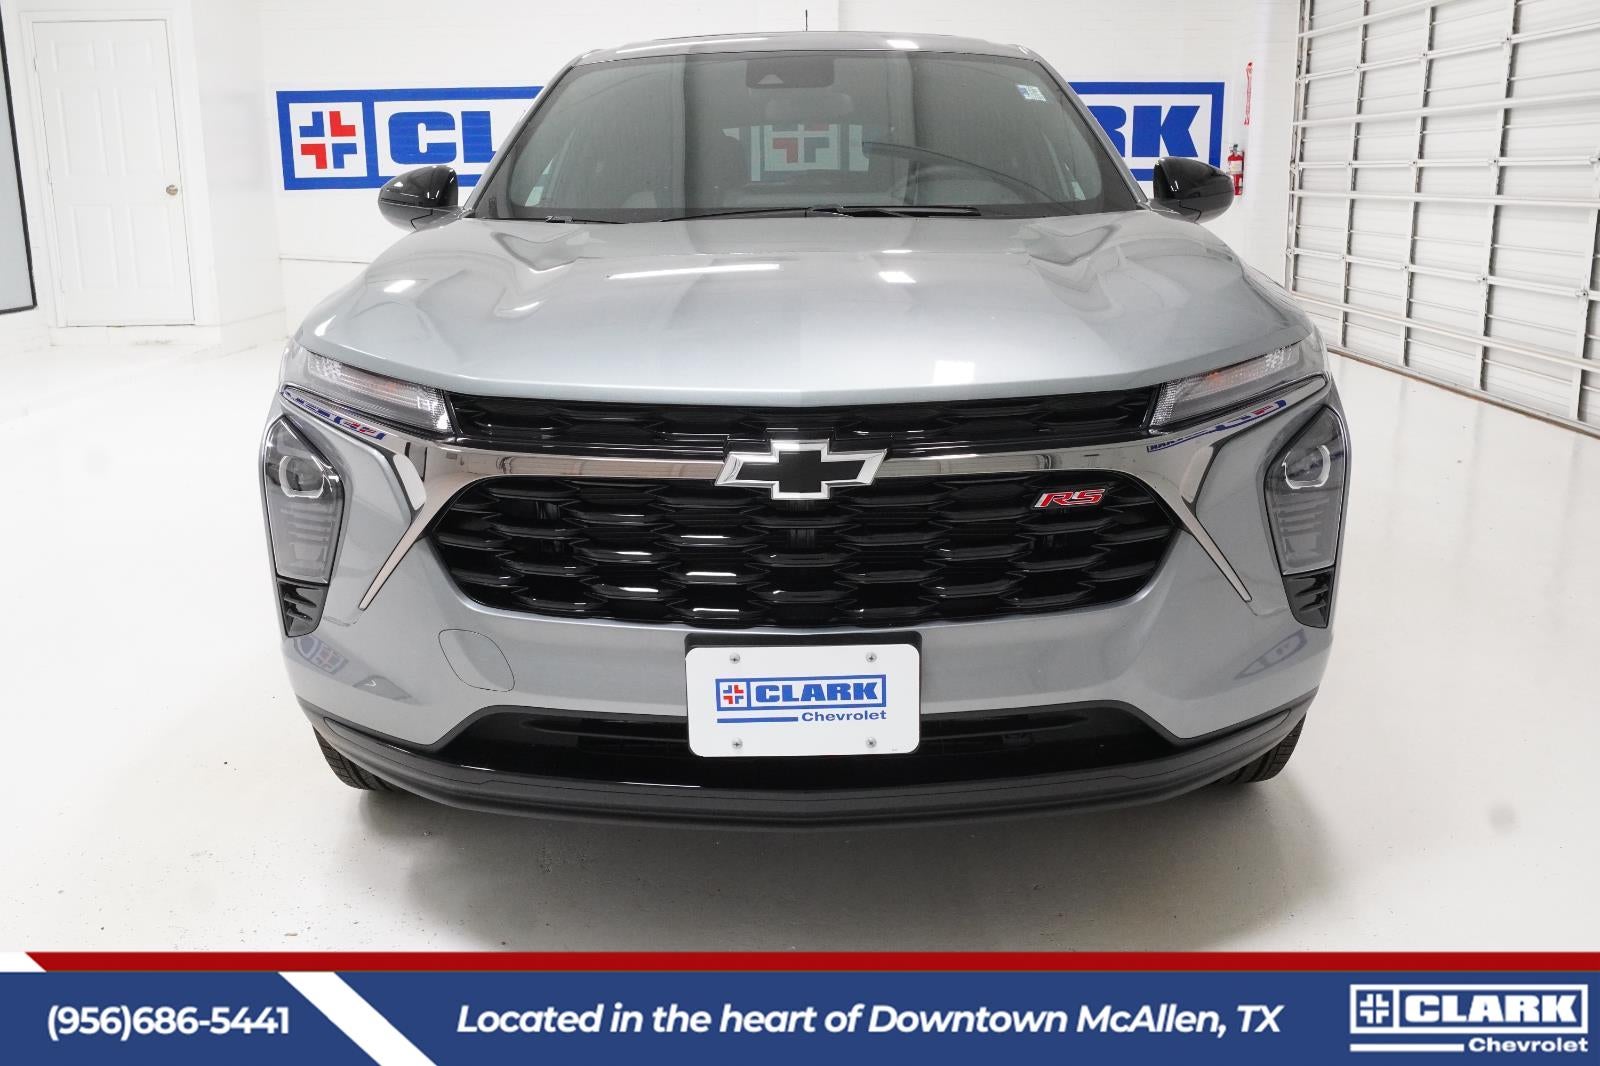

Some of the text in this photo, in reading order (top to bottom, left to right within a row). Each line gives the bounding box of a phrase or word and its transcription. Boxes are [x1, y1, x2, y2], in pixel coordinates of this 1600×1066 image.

[1034, 488, 1106, 508] RS
[755, 681, 878, 703] CLARK
[801, 709, 887, 722] Chevrolet
